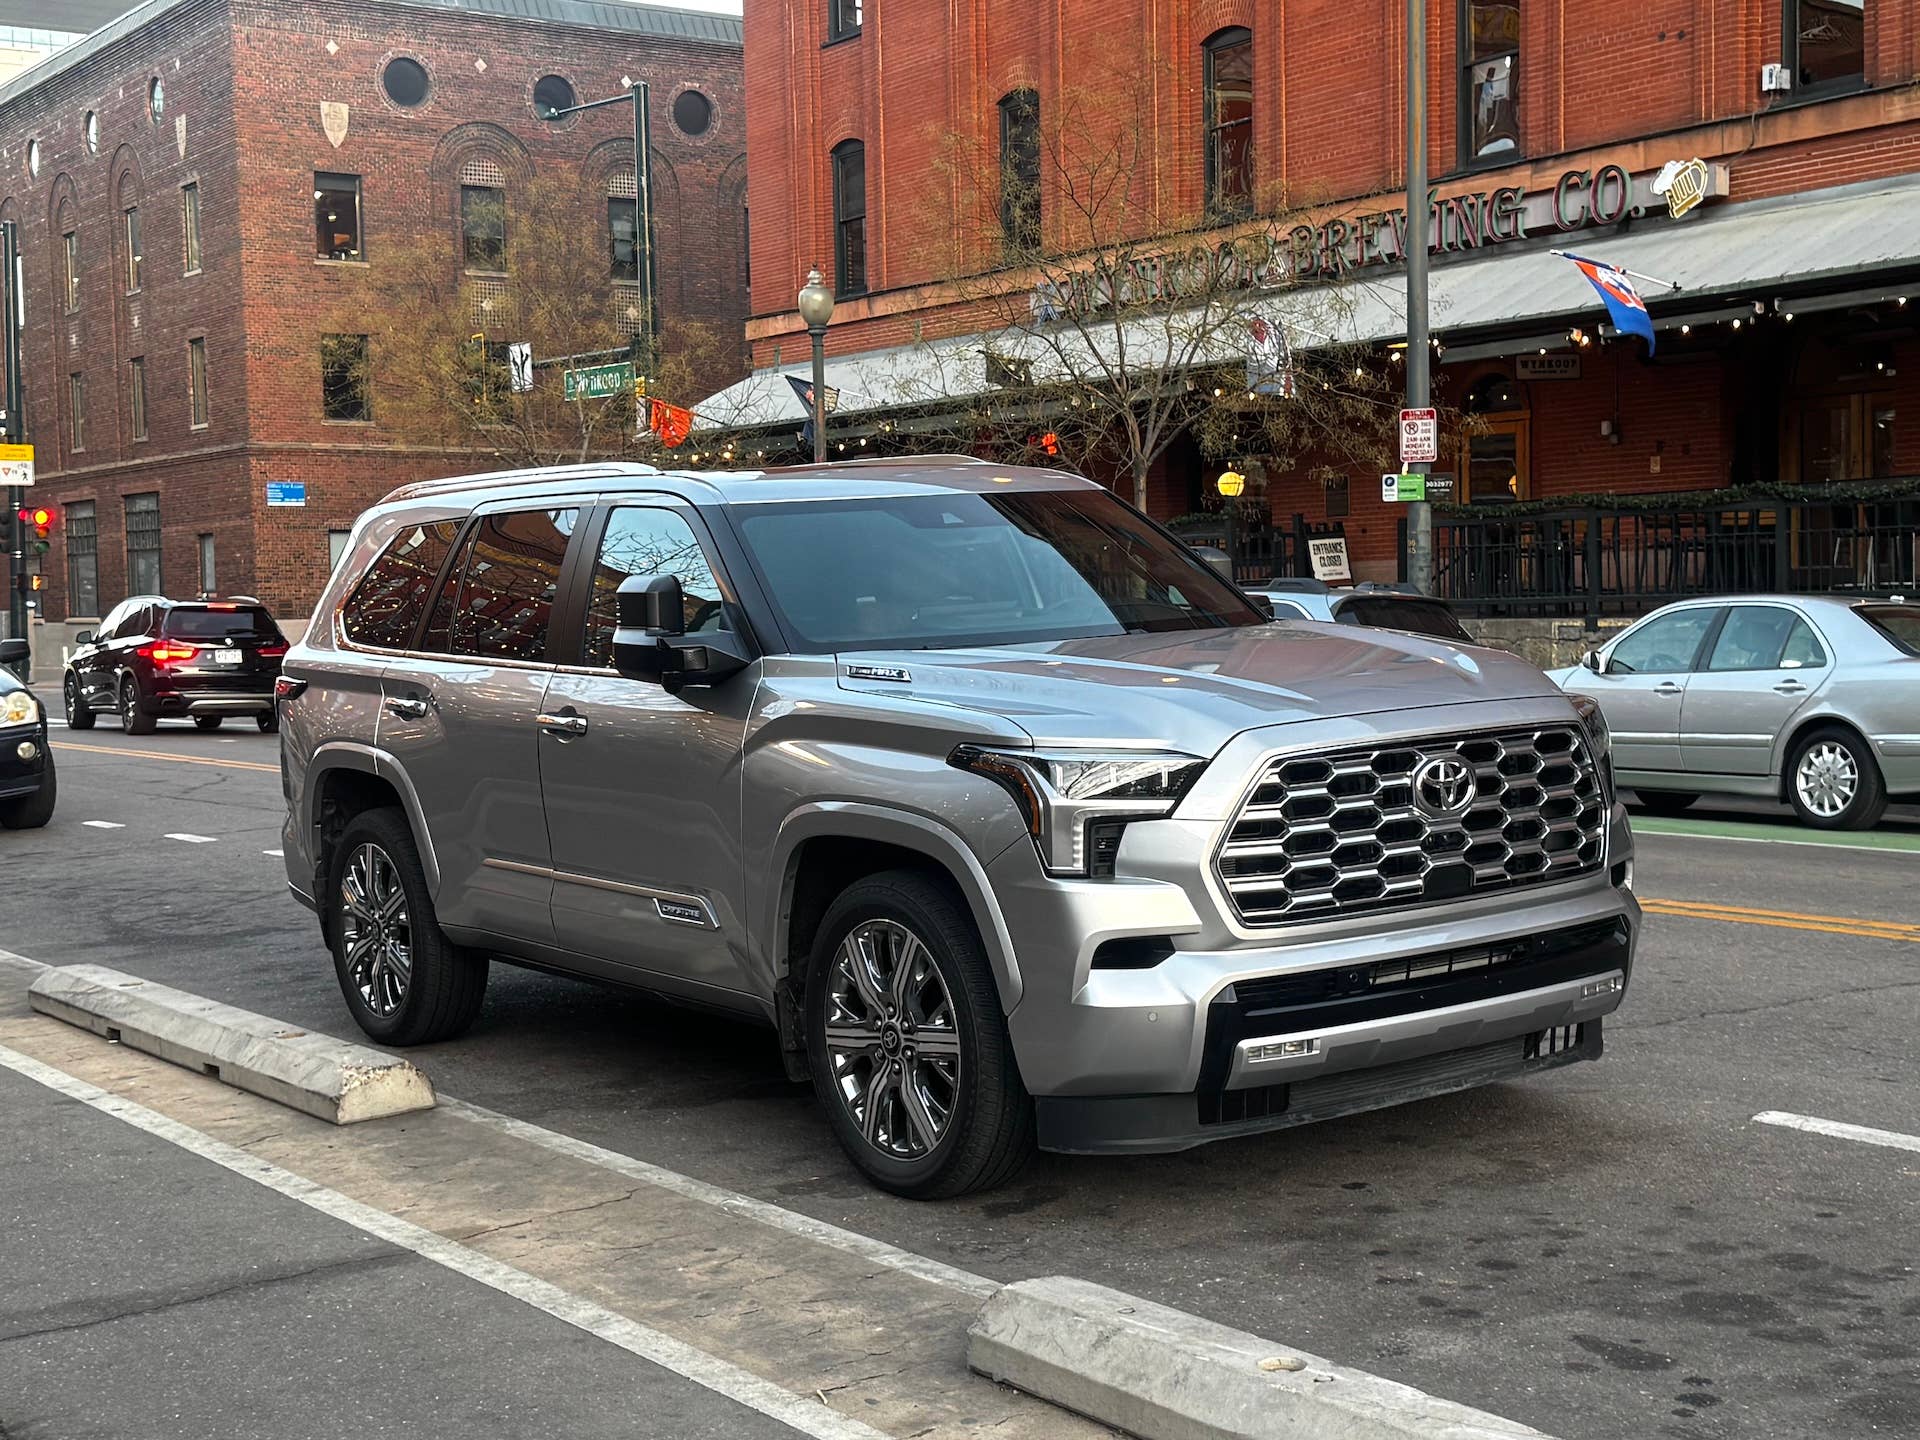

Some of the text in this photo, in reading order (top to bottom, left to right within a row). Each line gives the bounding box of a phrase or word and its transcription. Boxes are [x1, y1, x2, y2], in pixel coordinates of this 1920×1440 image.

[1288, 186, 1528, 275] BREWING
[1552, 164, 1646, 232] CO.
[1312, 542, 1344, 555] ENTRANCE
[1319, 556, 1342, 567] CLOSED
[871, 667, 898, 677] MAX
